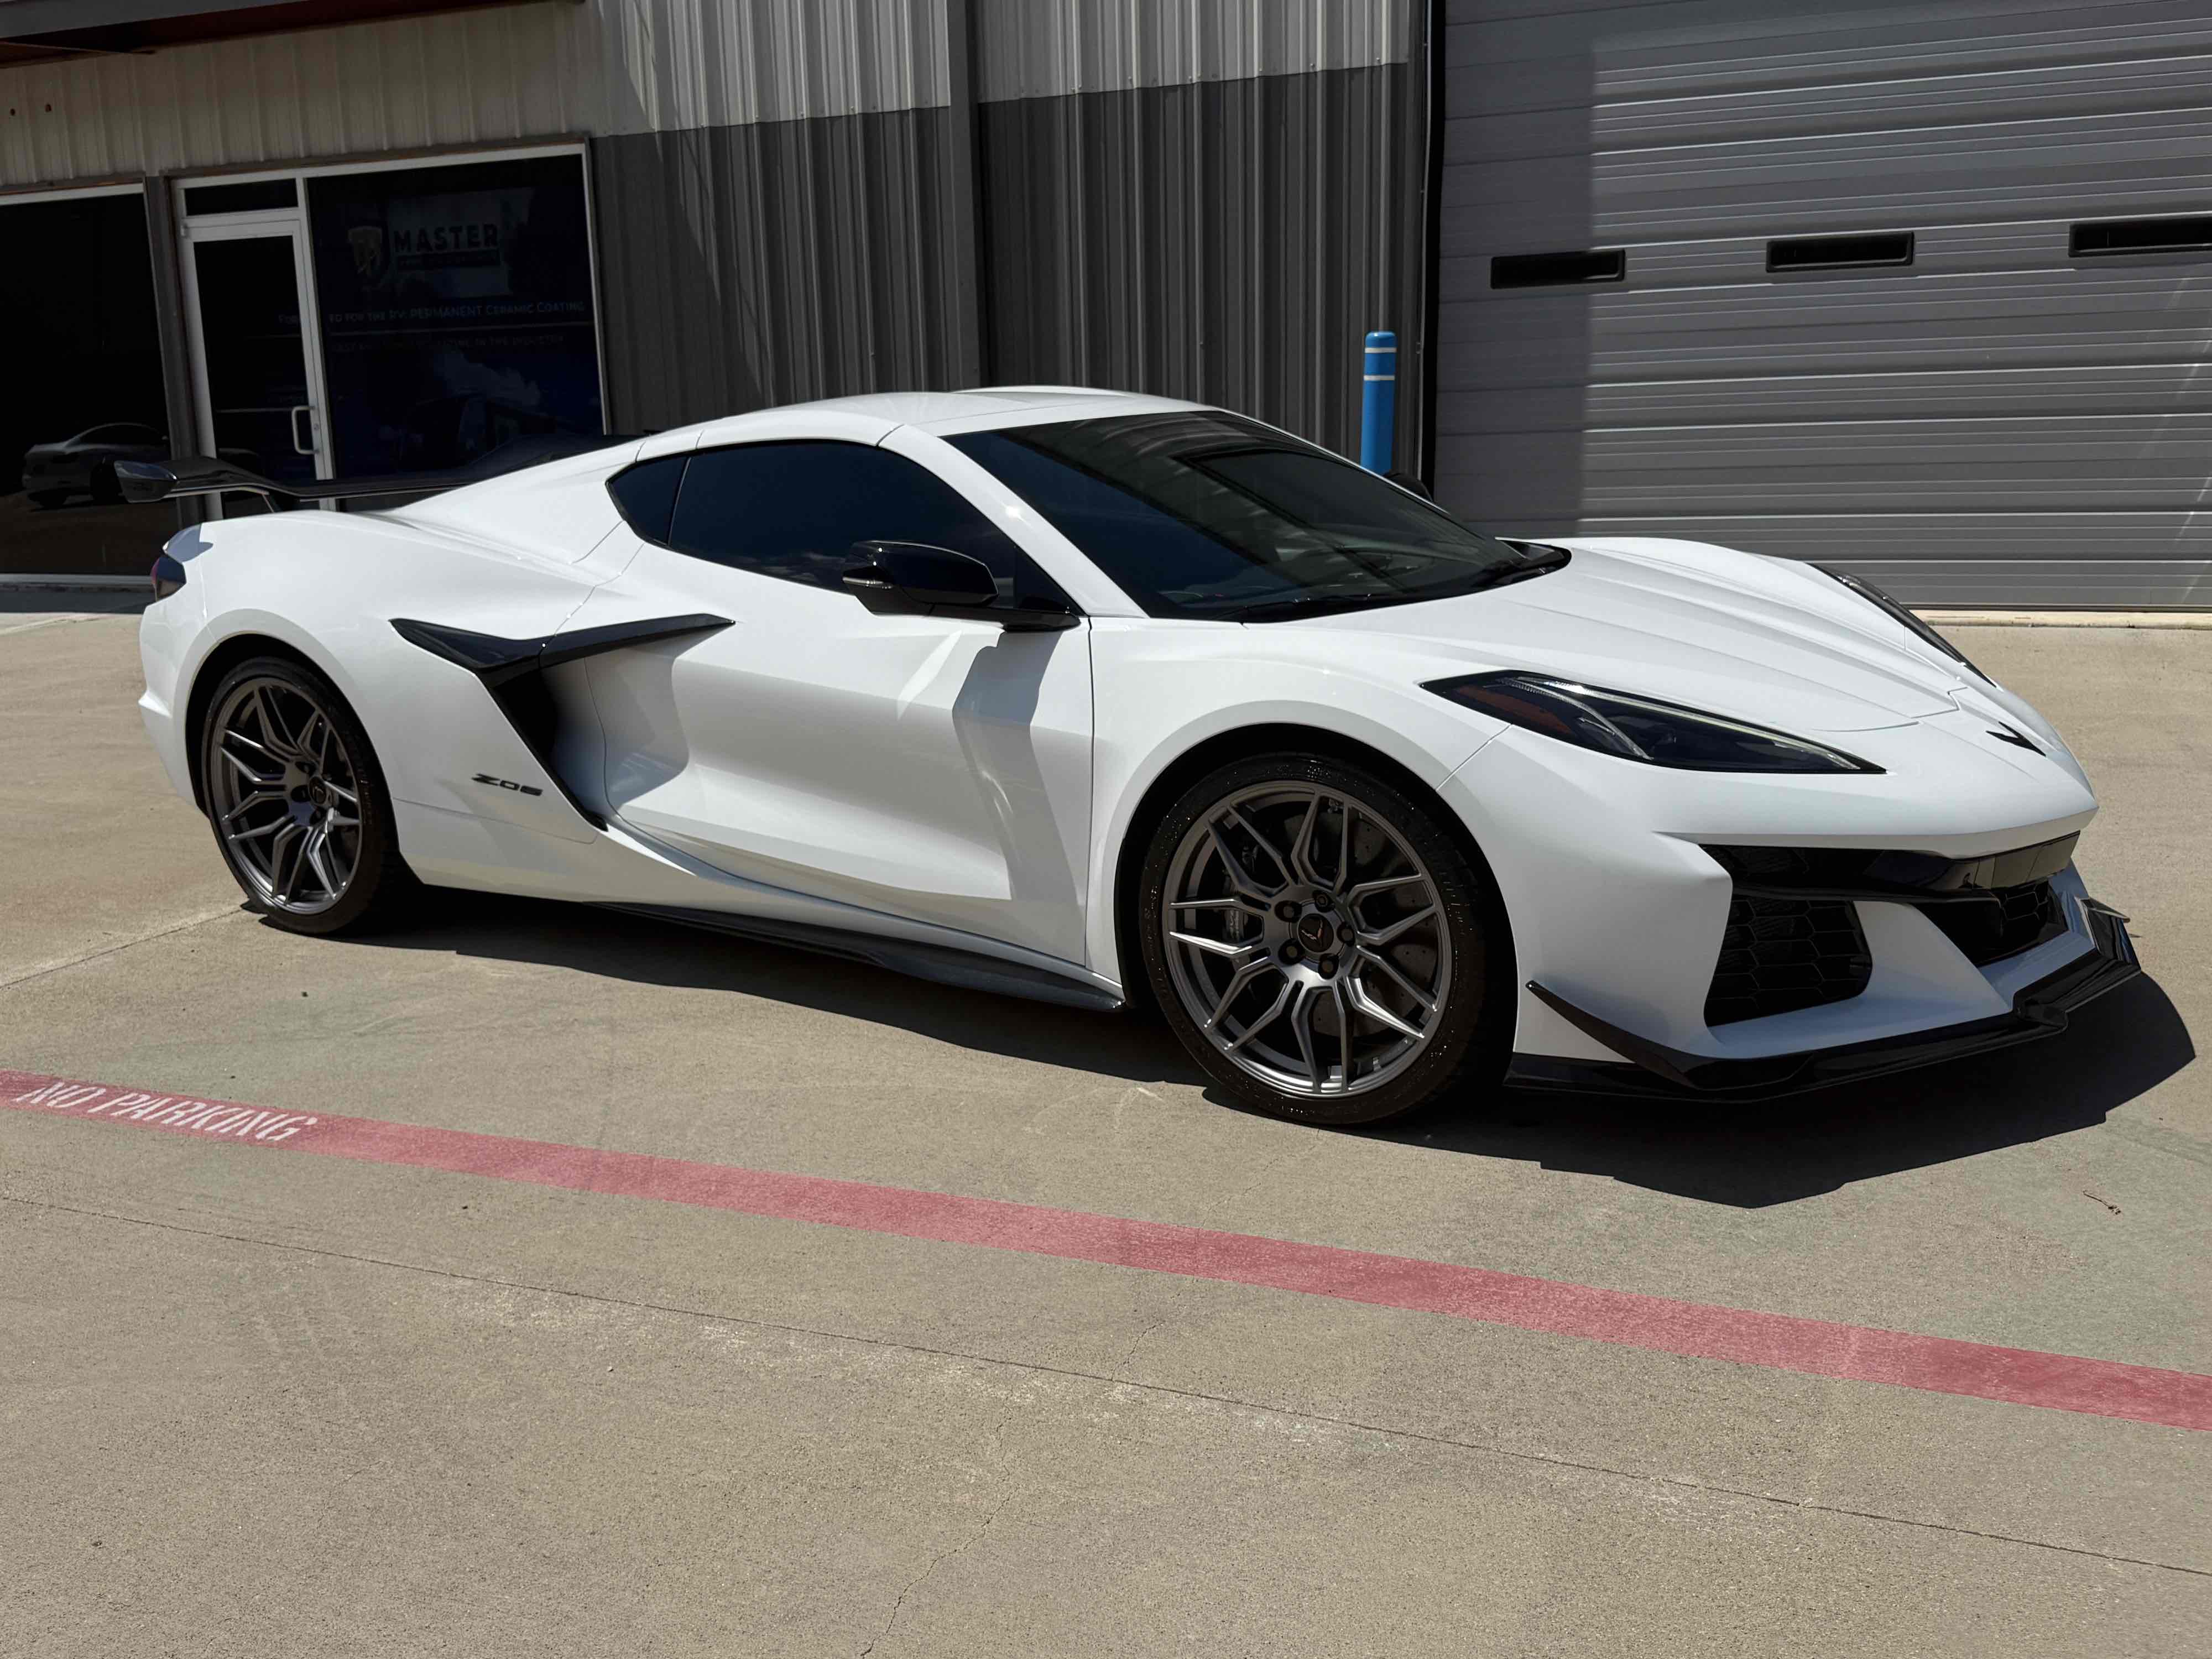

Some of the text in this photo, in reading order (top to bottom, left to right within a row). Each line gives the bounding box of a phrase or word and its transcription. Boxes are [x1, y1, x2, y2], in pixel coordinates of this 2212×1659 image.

[393, 223, 499, 253] MASTER
[411, 305, 483, 319] PERMANENT
[537, 301, 585, 313] COATING
[12, 1082, 318, 1141] NO PARKING
